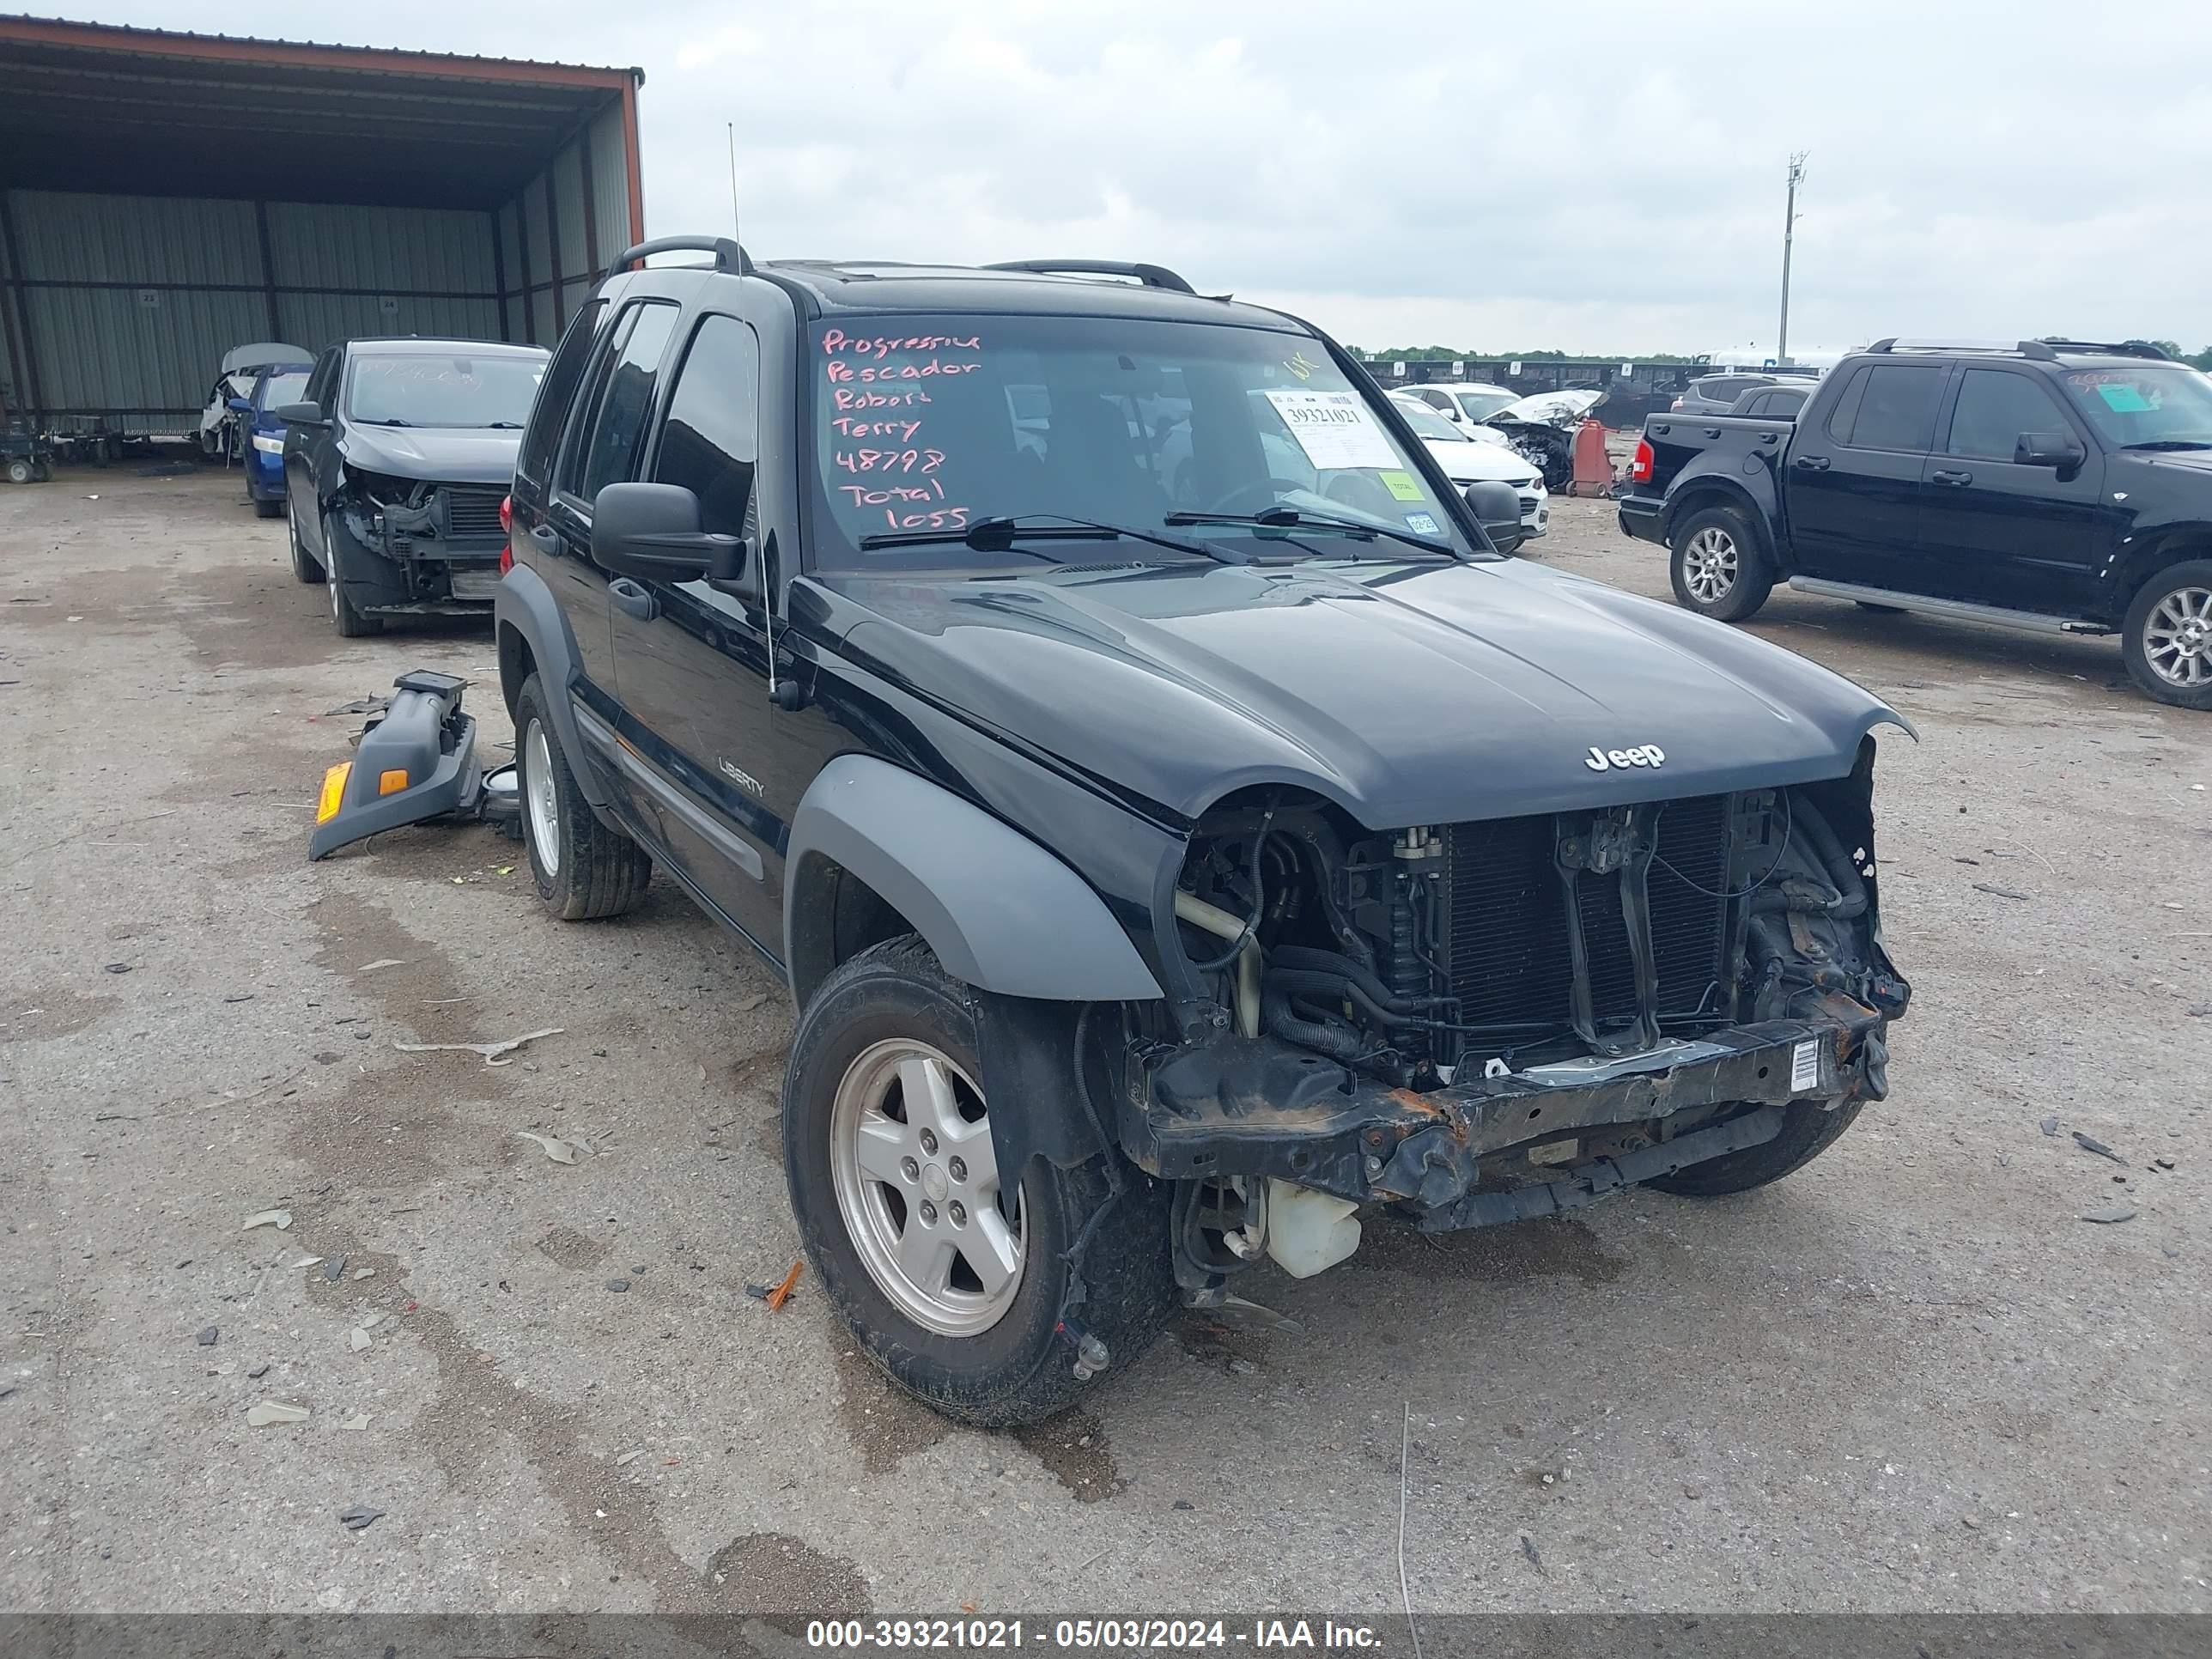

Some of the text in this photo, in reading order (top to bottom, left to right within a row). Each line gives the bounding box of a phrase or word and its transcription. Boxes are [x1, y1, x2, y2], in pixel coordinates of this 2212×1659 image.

[827, 359, 981, 383] Pescador
[1287, 408, 1361, 423] 39321021
[832, 417, 921, 442] Terry
[838, 478, 945, 507] Total
[1585, 744, 1665, 771] Jeep
[719, 757, 765, 798] LIBERTY
